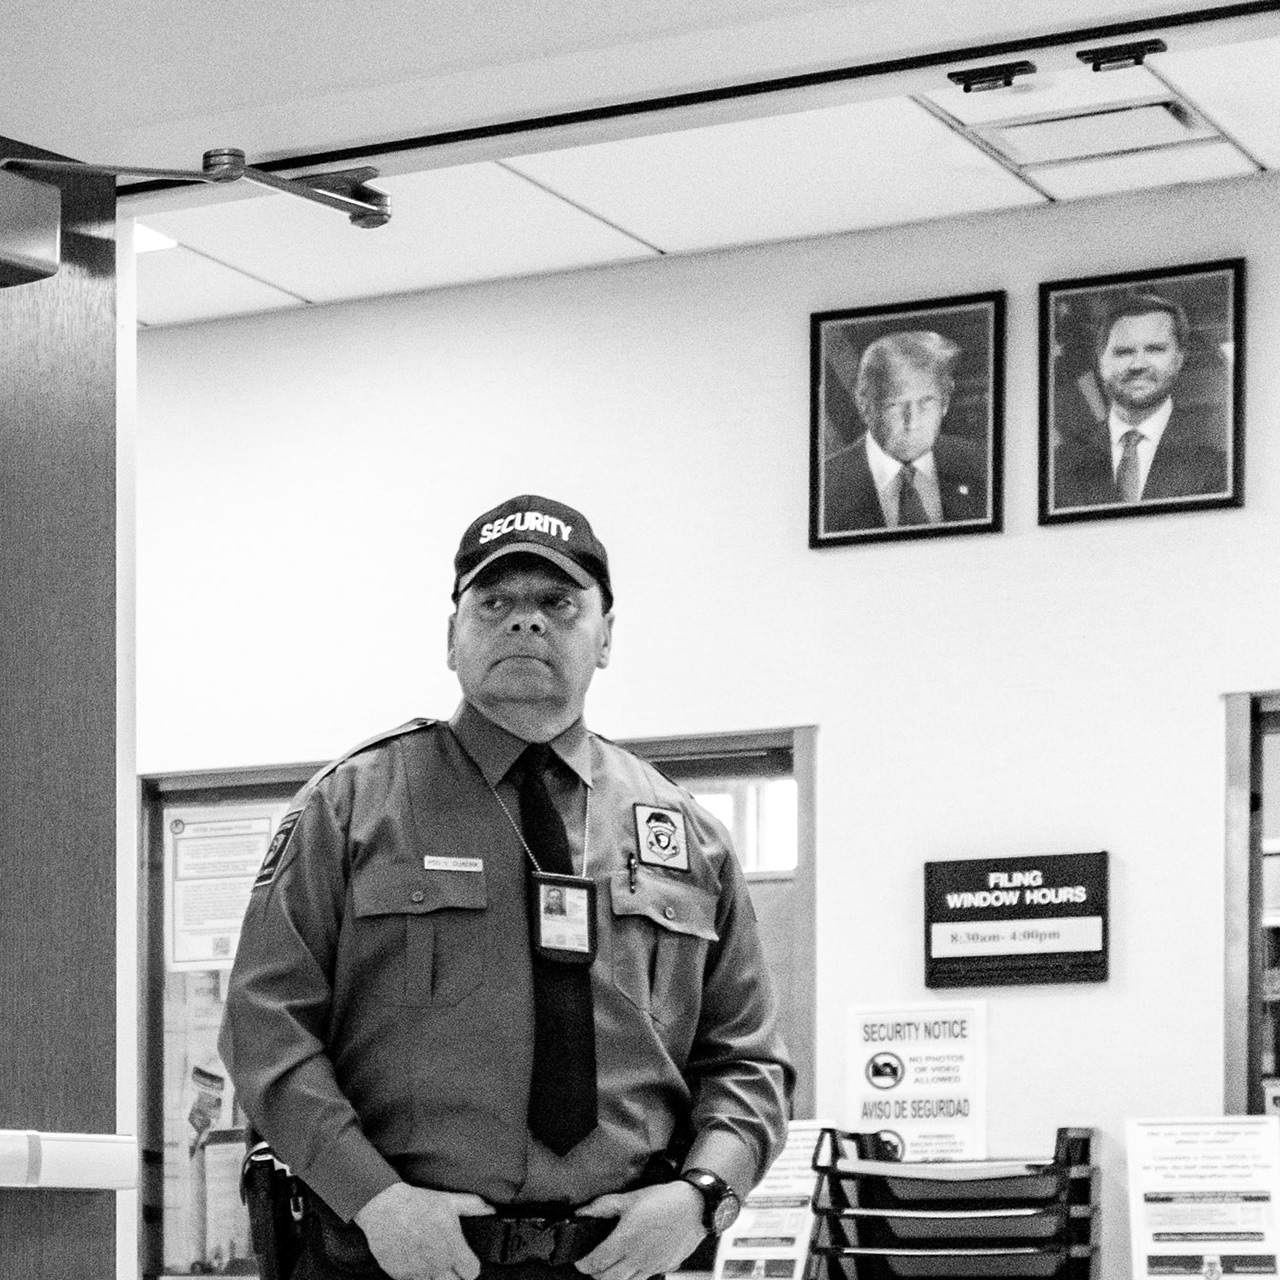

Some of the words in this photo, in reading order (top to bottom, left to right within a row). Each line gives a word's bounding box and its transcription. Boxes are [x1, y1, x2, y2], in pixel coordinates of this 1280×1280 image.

[479, 512, 572, 544] SECURITY
[990, 870, 1042, 888] FILING
[946, 890, 1020, 909] WINDOW
[1025, 886, 1086, 904] HOURS
[1010, 930, 1060, 943] 4:00pm
[863, 1022, 920, 1042] SECURITY
[924, 1020, 967, 1040] NOTICE
[925, 1054, 964, 1062] PHOTOS
[931, 1065, 959, 1073] VIDEO
[913, 1076, 961, 1084] ALLOWED
[862, 1101, 891, 1119] AVISO
[895, 1100, 907, 1118] DE
[911, 1099, 970, 1118] SEGURIDAD
